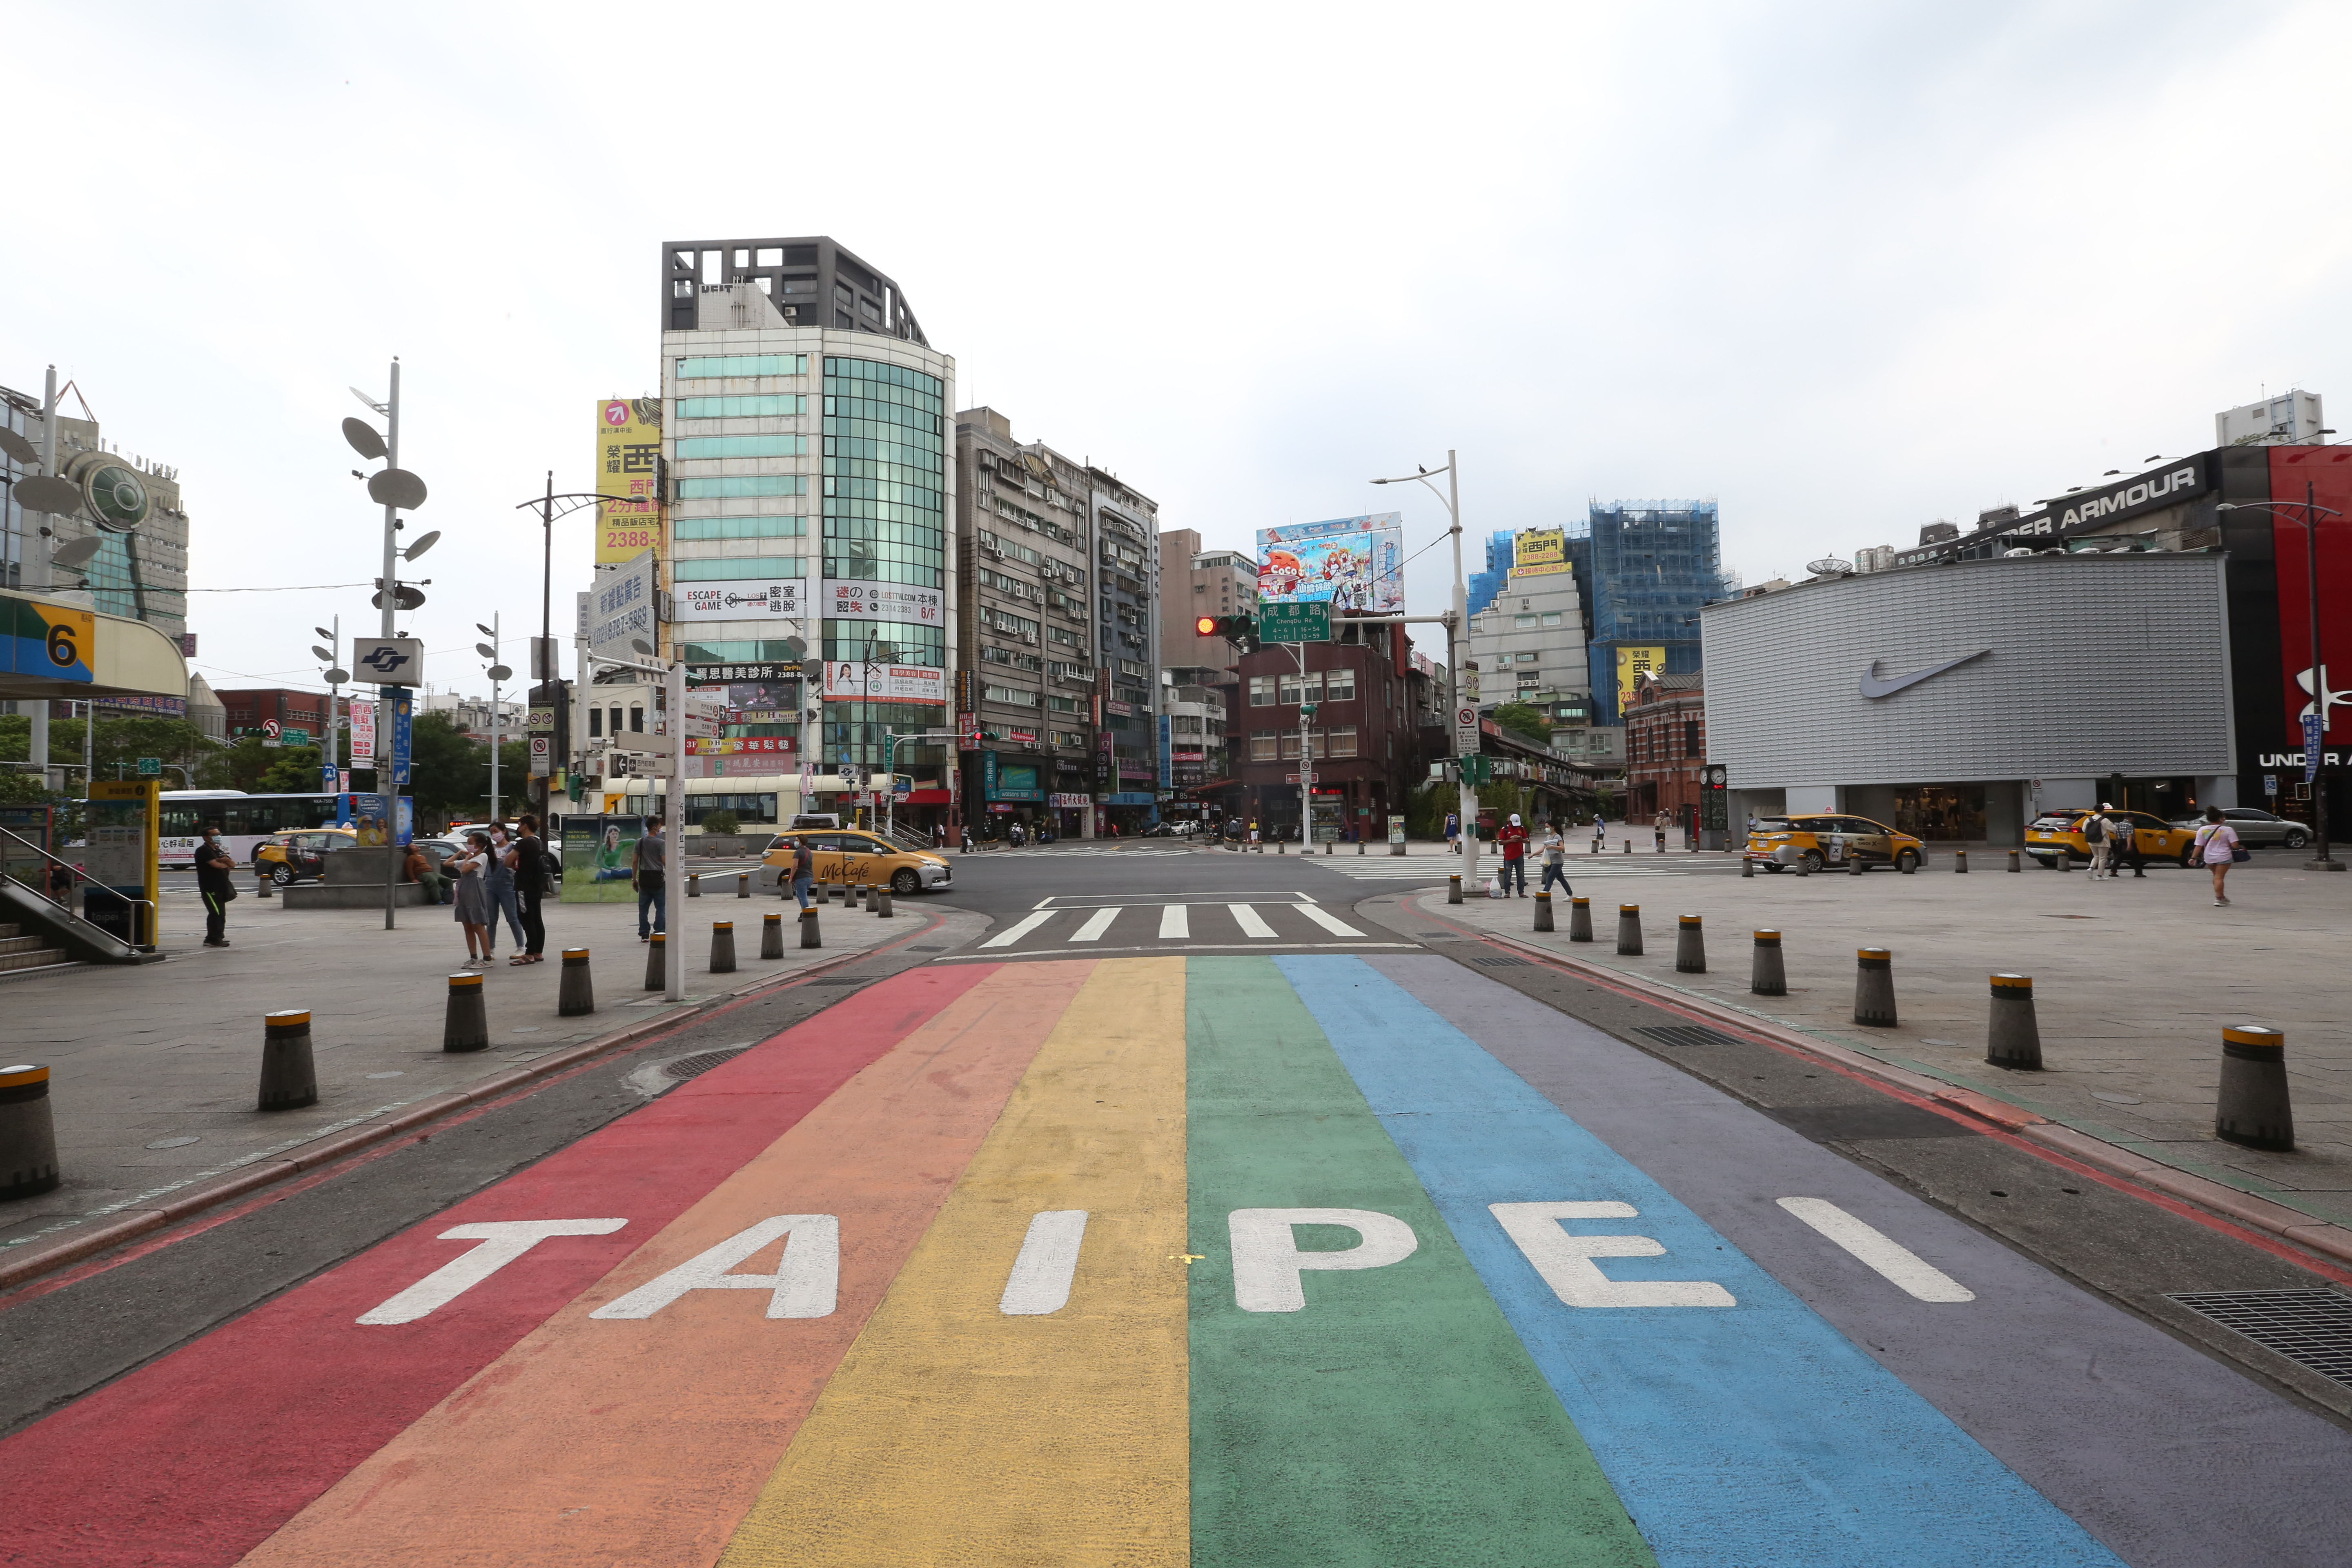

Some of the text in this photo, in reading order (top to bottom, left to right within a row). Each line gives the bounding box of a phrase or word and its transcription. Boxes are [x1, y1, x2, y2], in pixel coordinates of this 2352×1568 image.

[606, 444, 620, 473] 榮耀
[2060, 466, 2195, 530] ARMOUR
[1528, 539, 1557, 553] 西門
[1523, 552, 1557, 561] 2388-2288
[1525, 564, 1564, 575] 接待中心到了
[769, 586, 795, 598] 密室
[836, 586, 862, 598] 迷の
[1296, 580, 1334, 594] 仙境好飲
[687, 590, 722, 600] ESCAPE
[881, 591, 916, 602] LOSTTW.COM
[918, 593, 938, 607] 本棟
[695, 601, 722, 610] GAME
[769, 600, 795, 612] 逃脫
[881, 604, 911, 614] 2314 2383
[1267, 604, 1321, 617] 成都路
[921, 607, 935, 620] 6/F
[47, 624, 78, 667] 6
[1633, 650, 1650, 658] 榮耀
[696, 666, 773, 680] 麗思醫美診所
[733, 739, 789, 751] 黛華髮藝
[2259, 753, 2340, 767] UNDR
[610, 799, 617, 814] 1
[158, 838, 194, 848] 心好禮展
[822, 861, 870, 882] McCafé
